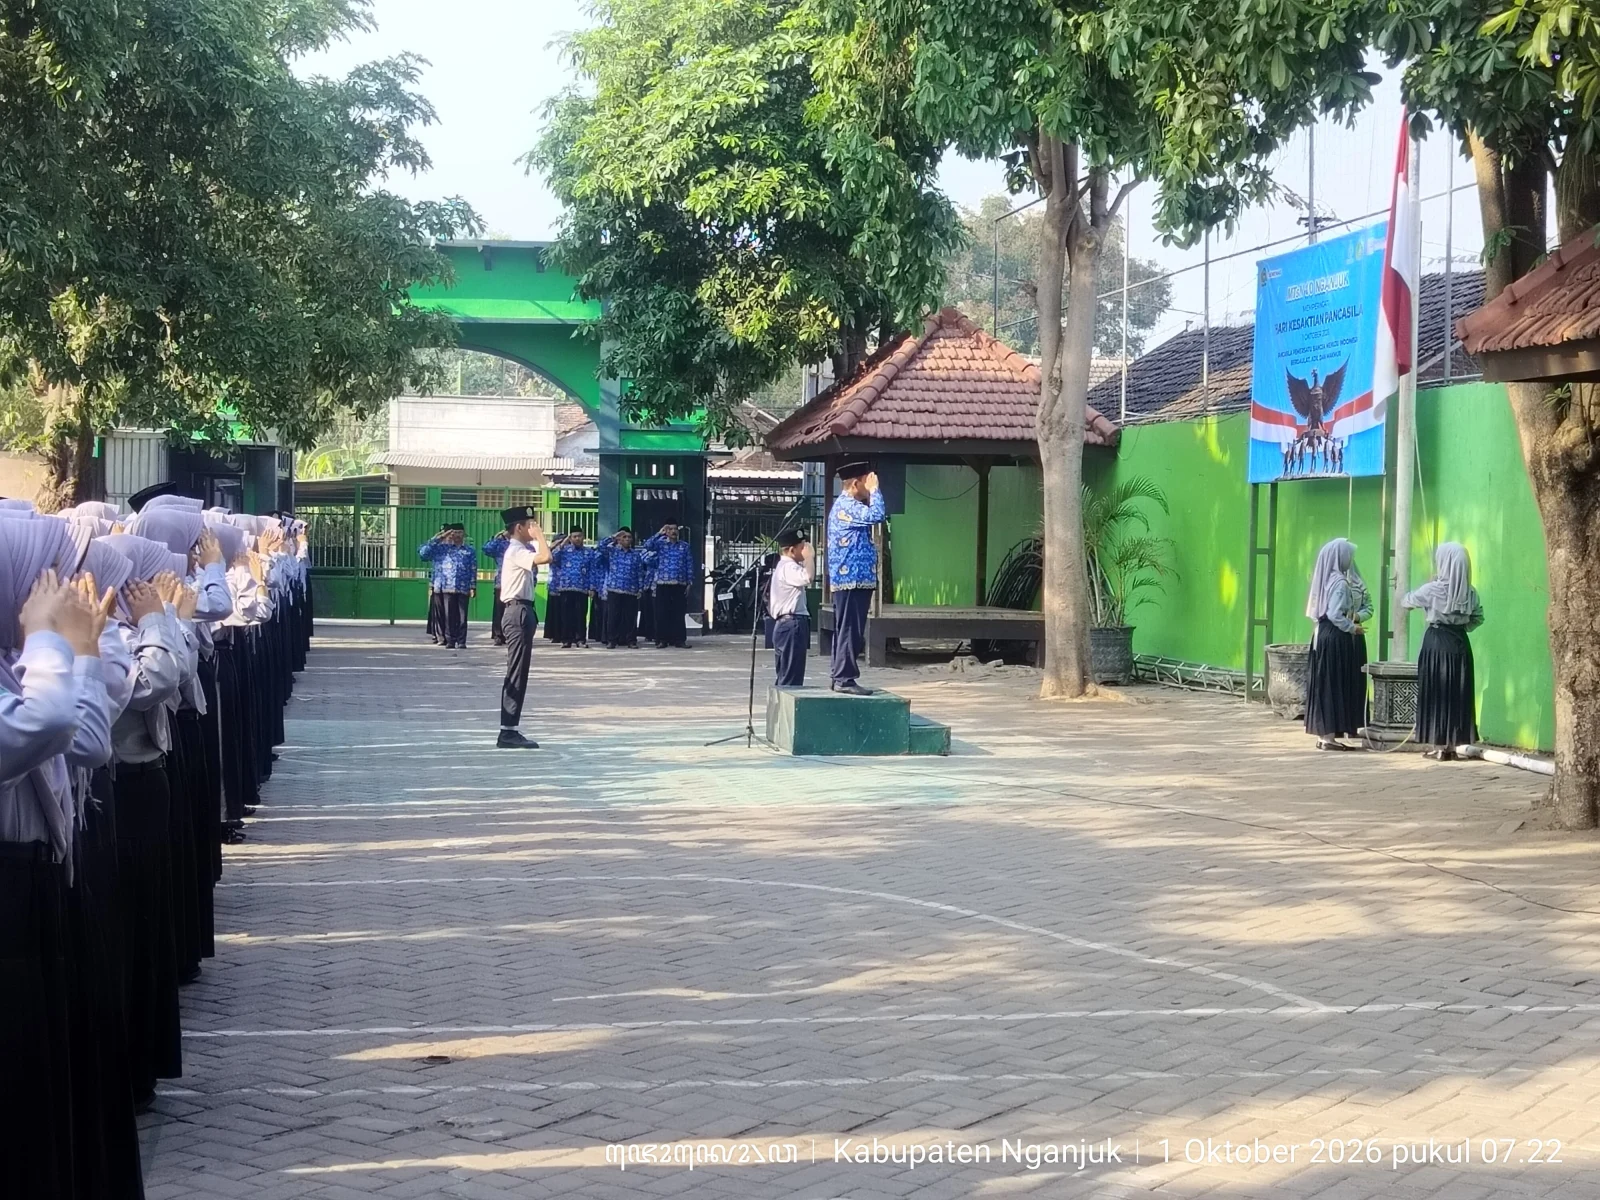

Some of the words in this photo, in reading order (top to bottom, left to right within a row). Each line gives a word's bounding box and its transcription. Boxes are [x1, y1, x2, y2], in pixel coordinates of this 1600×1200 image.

[1315, 270, 1350, 295] NGANJUK
[1289, 312, 1325, 332] KESAKTIAN
[1325, 304, 1363, 324] PANCASILA
